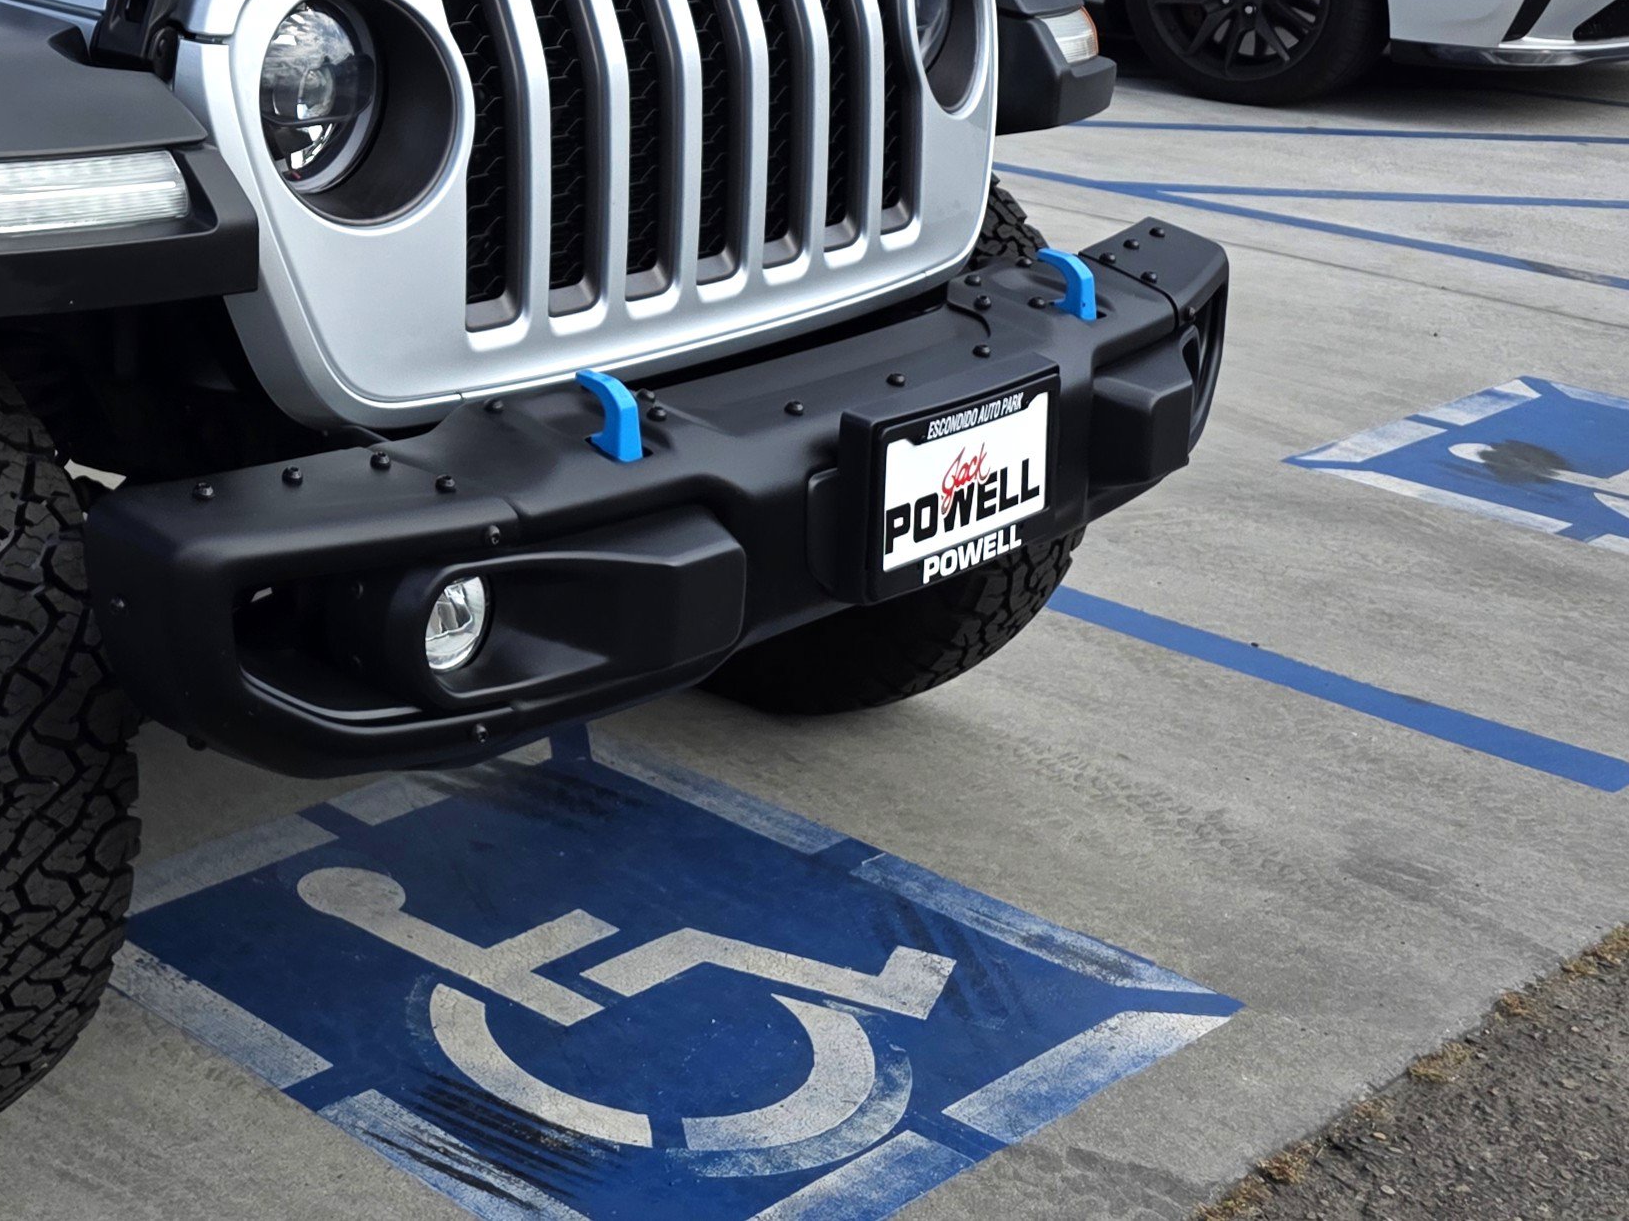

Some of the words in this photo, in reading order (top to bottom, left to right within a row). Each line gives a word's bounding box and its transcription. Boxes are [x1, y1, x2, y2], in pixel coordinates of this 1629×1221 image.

[927, 408, 978, 440] ESCONDIDO
[978, 402, 1001, 422] AUTO
[999, 391, 1024, 417] PARK
[884, 458, 1040, 555] POWELL
[941, 442, 991, 515] Jack
[922, 524, 1022, 584] POWELL
